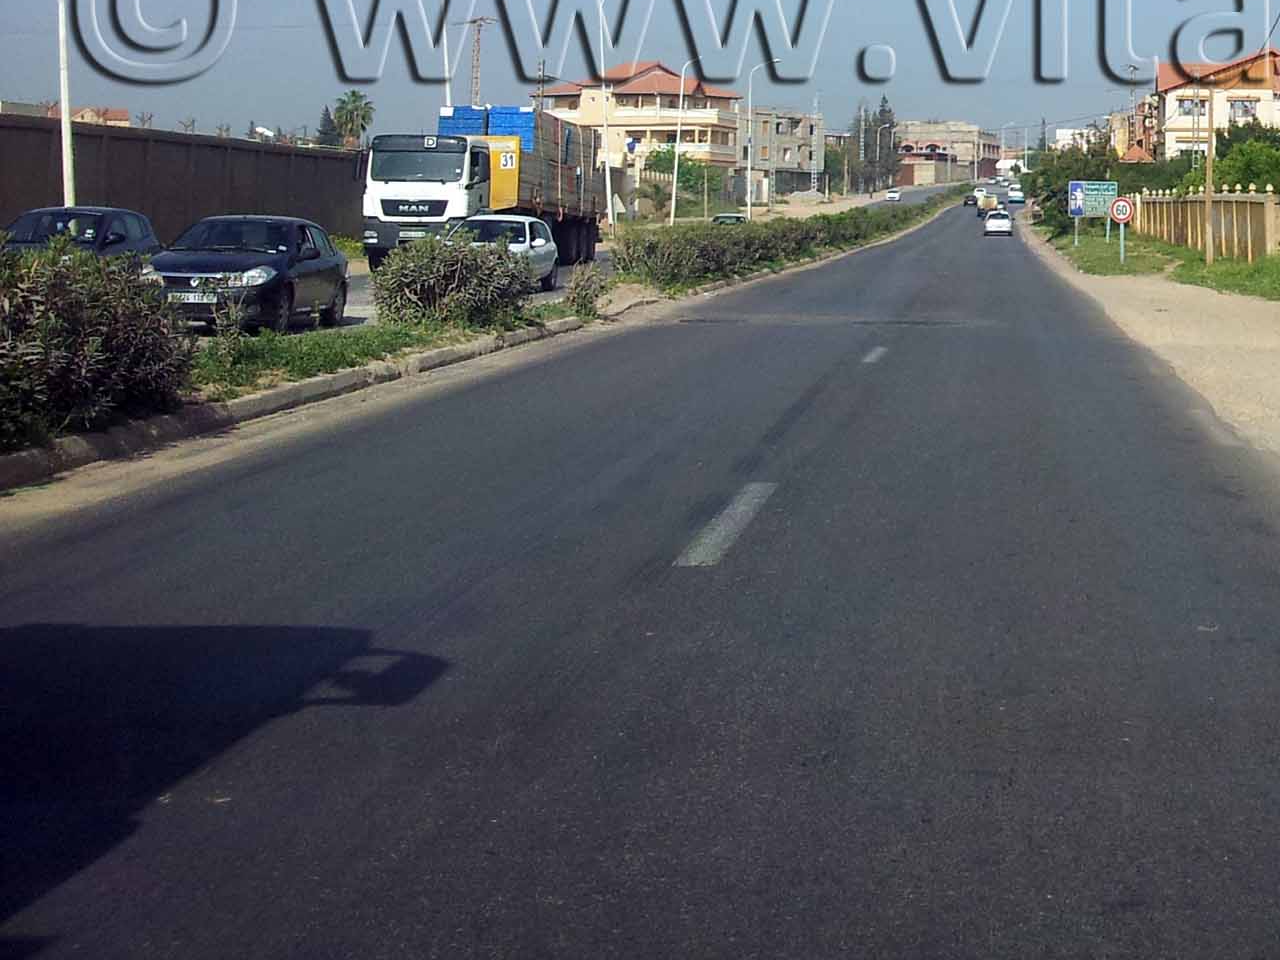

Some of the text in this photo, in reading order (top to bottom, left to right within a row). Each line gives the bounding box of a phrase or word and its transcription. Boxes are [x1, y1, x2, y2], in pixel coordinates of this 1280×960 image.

[427, 138, 435, 146] D
[502, 154, 514, 167] 31
[398, 204, 429, 212] MAN
[1116, 204, 1128, 216] 60
